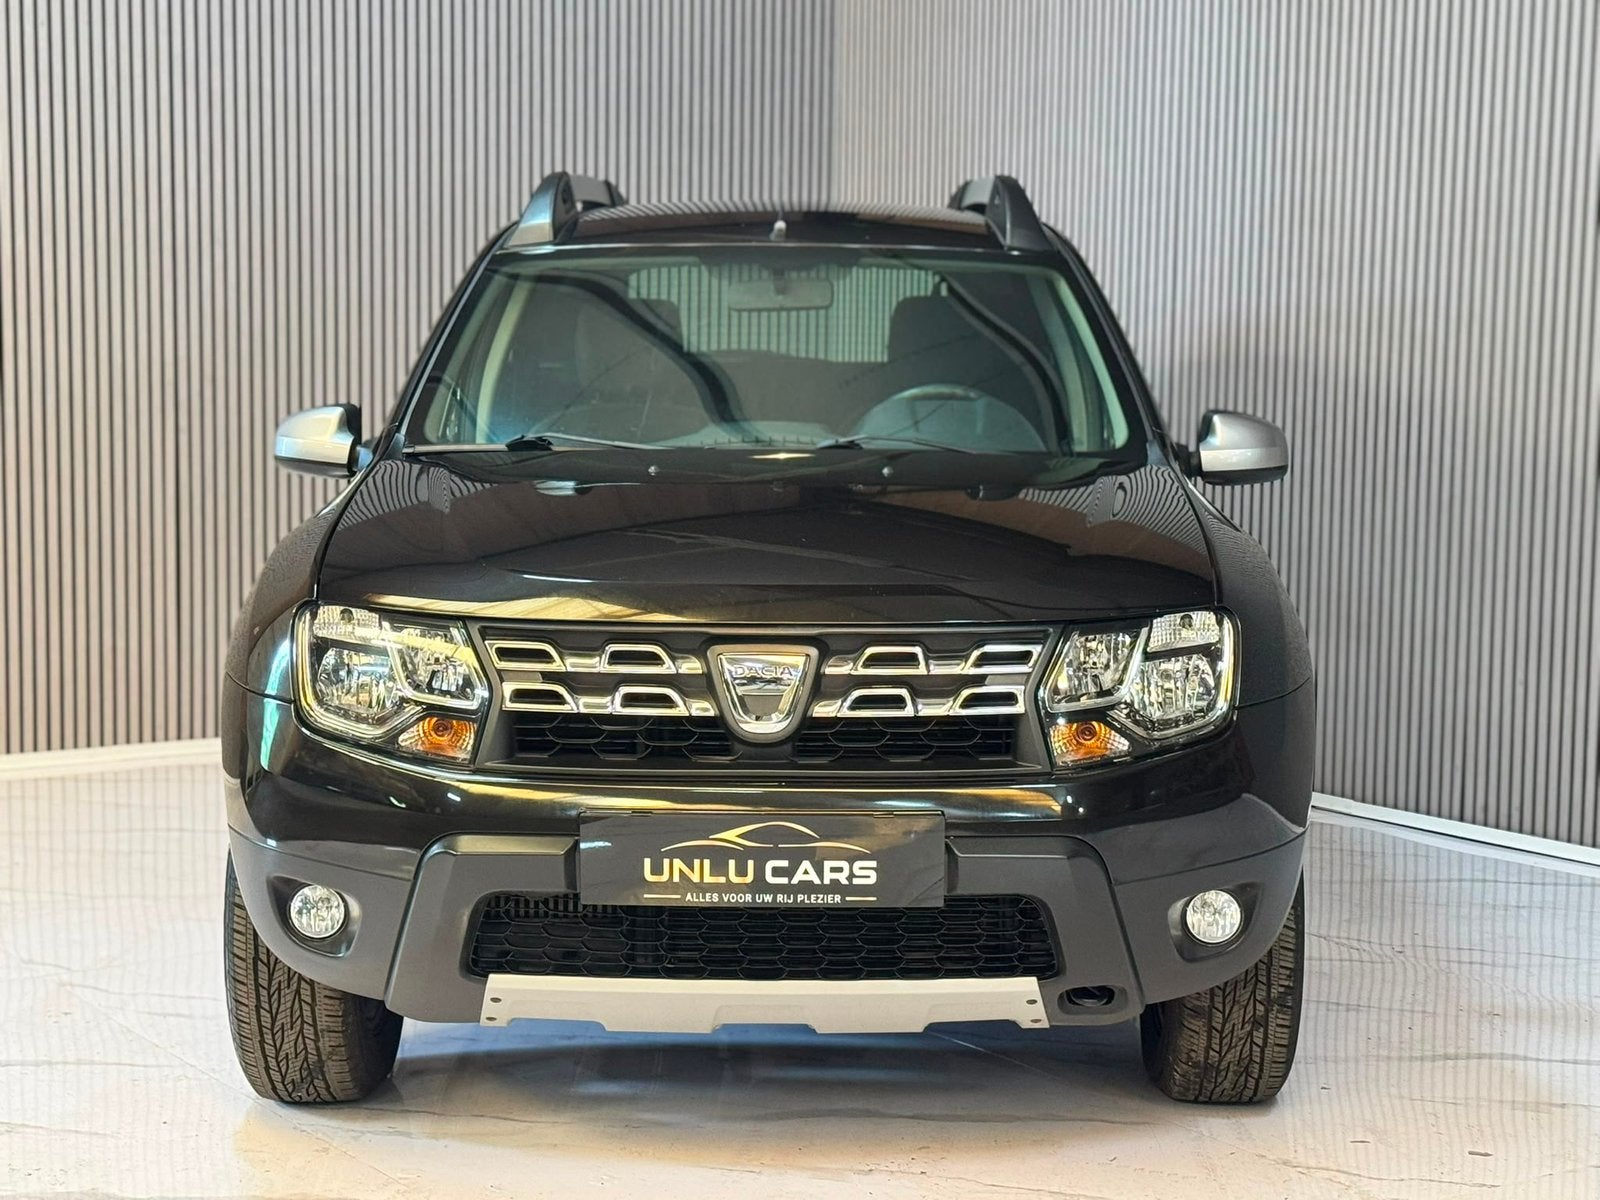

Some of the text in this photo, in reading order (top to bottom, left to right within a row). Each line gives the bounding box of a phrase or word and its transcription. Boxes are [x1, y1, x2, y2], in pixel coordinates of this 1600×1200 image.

[733, 665, 793, 678] DACIA
[643, 858, 878, 885] UNLU CARS
[685, 892, 842, 904] ALLES VOOR UW RIJ PLEZIER
